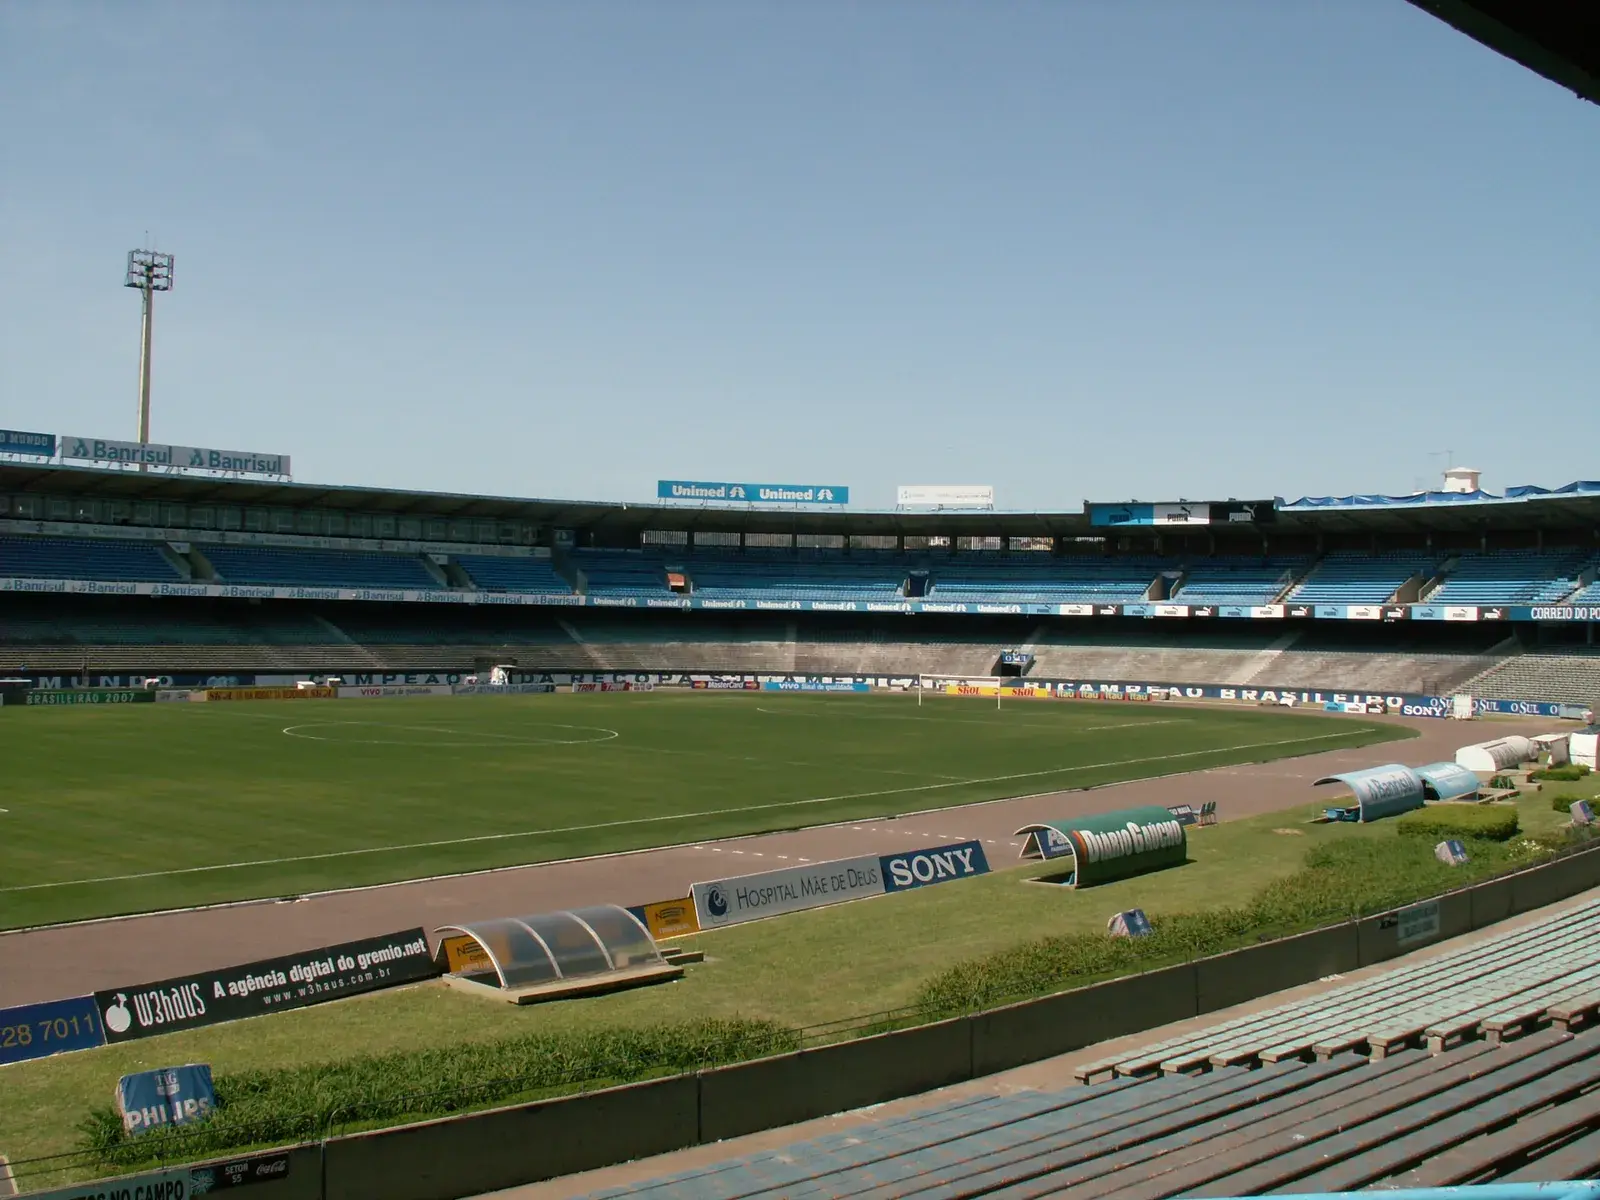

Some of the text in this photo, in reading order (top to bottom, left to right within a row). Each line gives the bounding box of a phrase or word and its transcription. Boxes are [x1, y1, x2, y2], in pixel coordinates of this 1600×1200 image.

[9, 433, 48, 446] MUNDO
[94, 441, 172, 464] Banrisul
[209, 450, 281, 472] Banrisul
[672, 485, 725, 497] Unimed
[760, 488, 813, 500] Unimed
[1531, 607, 1573, 620] CORREIO
[1574, 607, 1587, 620] DO
[707, 681, 744, 689] MasterCard
[956, 686, 980, 695] SKOL
[1012, 688, 1036, 696] SKOL
[105, 693, 135, 704] 2007
[1403, 705, 1442, 717] SONY
[890, 847, 973, 886] SONY
[735, 867, 877, 910] HOSPITAL MÃE DE DEUS
[214, 981, 226, 998] A
[228, 970, 287, 997] agência
[289, 957, 335, 982] digital
[337, 954, 354, 971] do
[357, 938, 427, 970] gremio.net
[263, 967, 391, 1005] www.w3haus.com.br
[38, 1013, 94, 1041] 7011
[126, 1097, 209, 1130] PHIIPS
[135, 1180, 184, 1200] CAMPO
